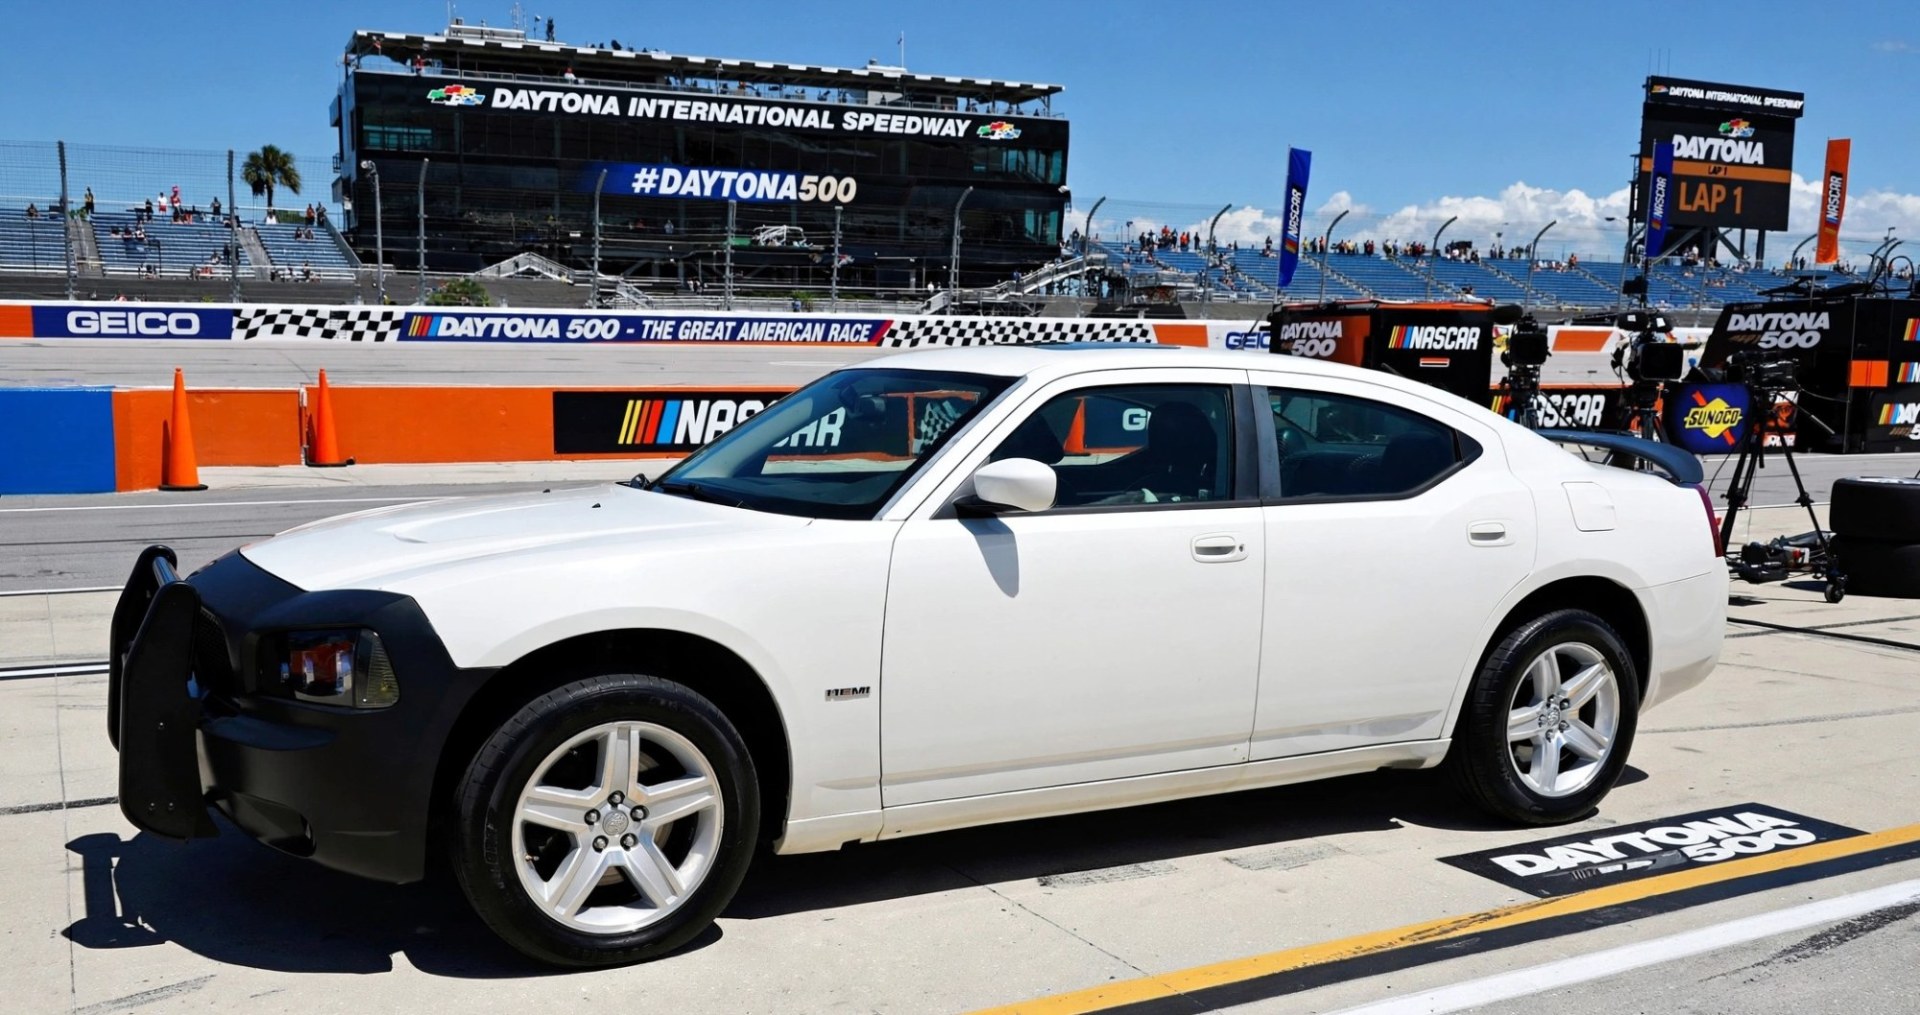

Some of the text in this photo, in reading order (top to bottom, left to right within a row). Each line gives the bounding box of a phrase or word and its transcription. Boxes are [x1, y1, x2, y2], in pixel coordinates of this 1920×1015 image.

[1668, 86, 1804, 110] DAYTONA INTERNATIONAL SPEEDWAY
[491, 88, 971, 138] DAYTONA INTERNATIONAL SPEEDWAY
[1672, 134, 1764, 165] DAYTONA
[1708, 165, 1723, 175] LAP
[631, 167, 857, 203] #DAYTONA500
[1653, 176, 1667, 217] NASCAR
[1678, 181, 1743, 214] LAP 1
[1826, 175, 1843, 221] NASCAR
[1287, 188, 1302, 238] NASCAR
[66, 310, 200, 335] GEICO
[437, 316, 560, 338] DAYTONA
[566, 317, 620, 340] 500
[641, 320, 676, 340] THE
[678, 320, 738, 341] GREAT
[736, 321, 826, 342] AMERICAN
[827, 323, 873, 343] RACE
[1280, 321, 1342, 340] DAYTONA
[1727, 312, 1829, 331] DAYTONA
[1291, 339, 1336, 357] 500
[1409, 326, 1480, 350] NASCAR
[1758, 331, 1821, 348] 500
[1688, 410, 1739, 426] SUNOCO
[1490, 812, 1800, 876] DAYTONA
[1680, 828, 1816, 862] 500
